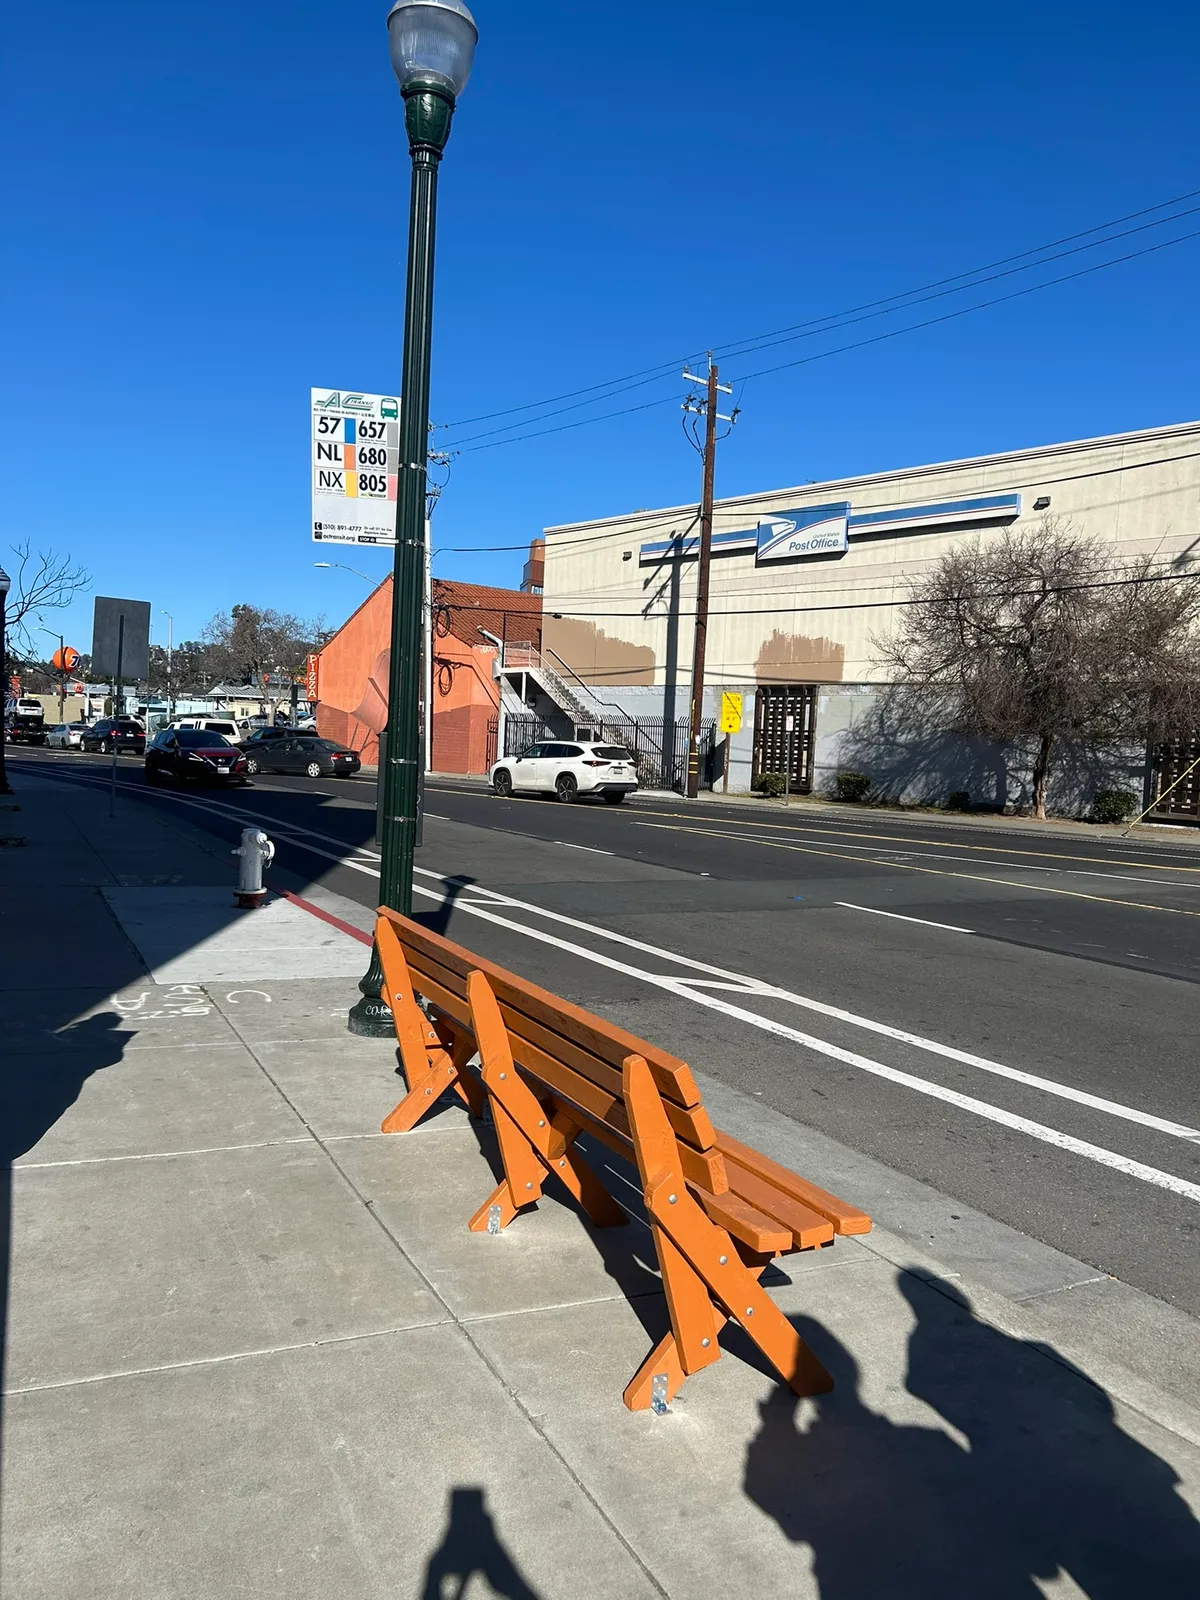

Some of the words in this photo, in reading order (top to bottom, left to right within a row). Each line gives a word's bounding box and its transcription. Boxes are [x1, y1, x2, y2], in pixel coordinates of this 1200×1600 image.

[318, 417, 341, 434] 57
[358, 421, 386, 439] 657
[317, 442, 342, 461] NL
[358, 447, 387, 466] 680
[319, 471, 343, 489] NX
[358, 474, 387, 493] 805
[337, 524, 362, 532] 891-4777
[323, 533, 355, 542] actransit.org
[789, 540, 810, 551] Post
[810, 538, 839, 549] Office
[307, 654, 318, 698] PIZZA
